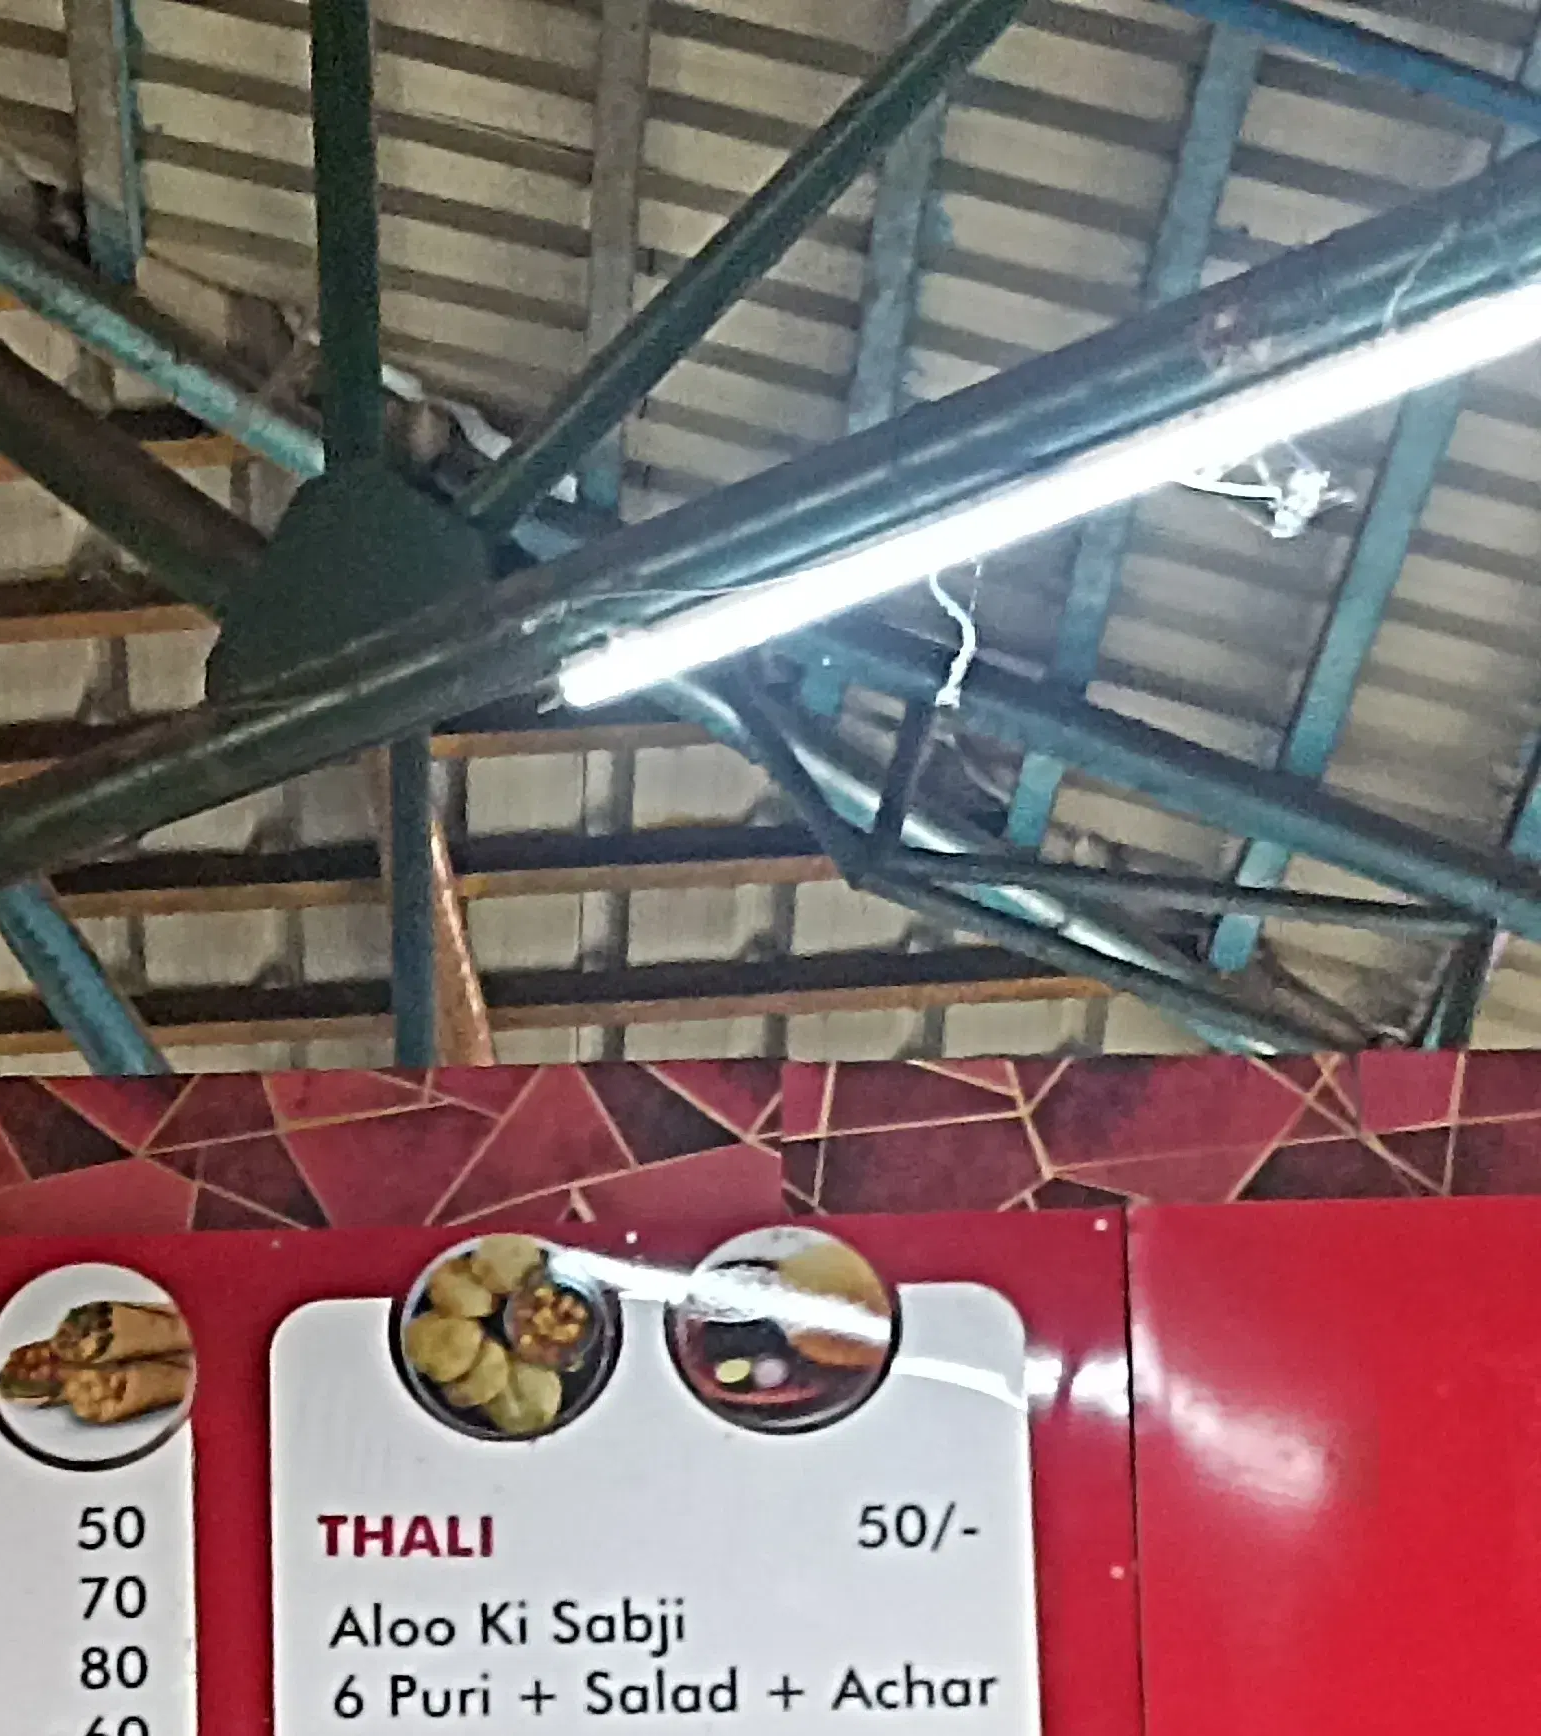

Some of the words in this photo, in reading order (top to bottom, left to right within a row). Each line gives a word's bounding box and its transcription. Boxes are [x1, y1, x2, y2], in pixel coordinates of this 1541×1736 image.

[77, 1505, 146, 1551] 50
[316, 1514, 494, 1558] THALI
[858, 1502, 978, 1551] 50/-
[80, 1575, 147, 1620] 70
[328, 1602, 456, 1649] Aloo
[480, 1600, 527, 1645] Ki
[552, 1597, 684, 1659] Sabji
[80, 1645, 149, 1690] 80
[334, 1674, 364, 1719] 6
[390, 1672, 490, 1718] Puri
[520, 1680, 557, 1716] +
[586, 1666, 738, 1715] Salad
[768, 1675, 805, 1711] +
[831, 1663, 998, 1711] Achar
